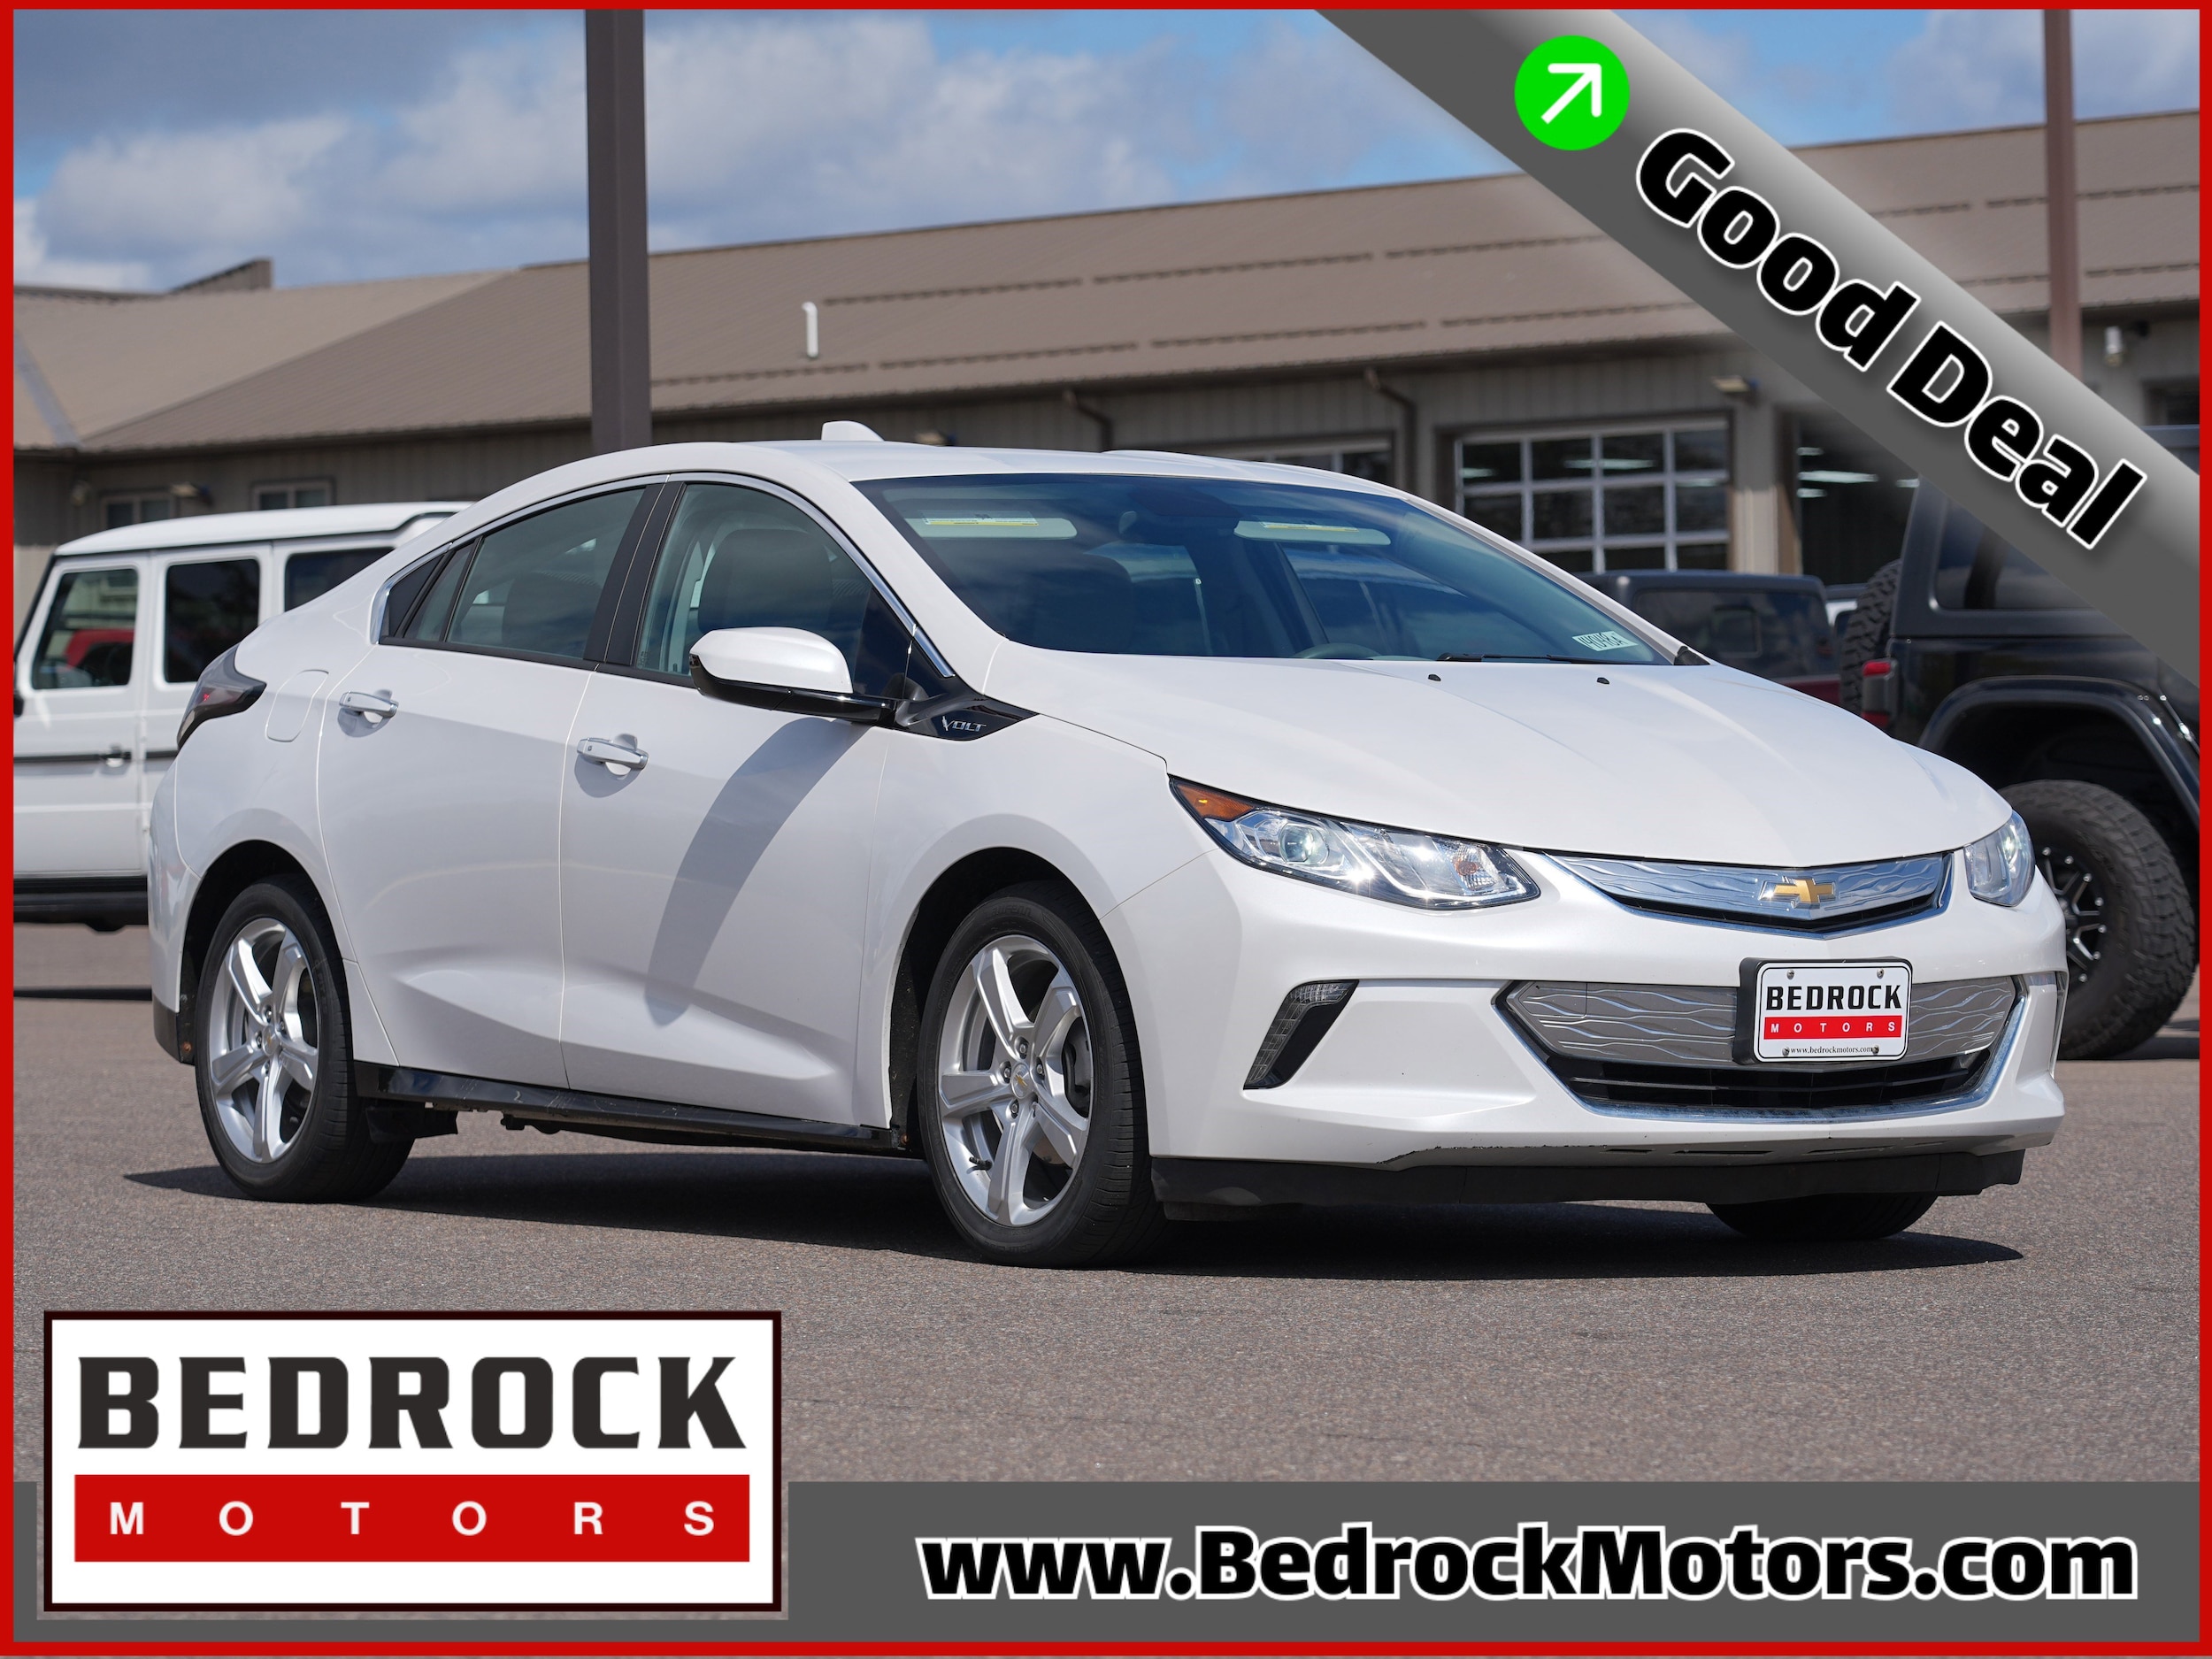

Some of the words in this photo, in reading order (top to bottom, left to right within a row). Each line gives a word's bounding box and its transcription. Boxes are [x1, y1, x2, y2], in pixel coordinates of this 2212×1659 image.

[942, 716, 987, 731] VOLT
[1765, 985, 1901, 1010] BEDROCK
[1770, 1021, 1895, 1033] MOTORS
[1790, 1045, 1874, 1054] www.bedrockmotors.com
